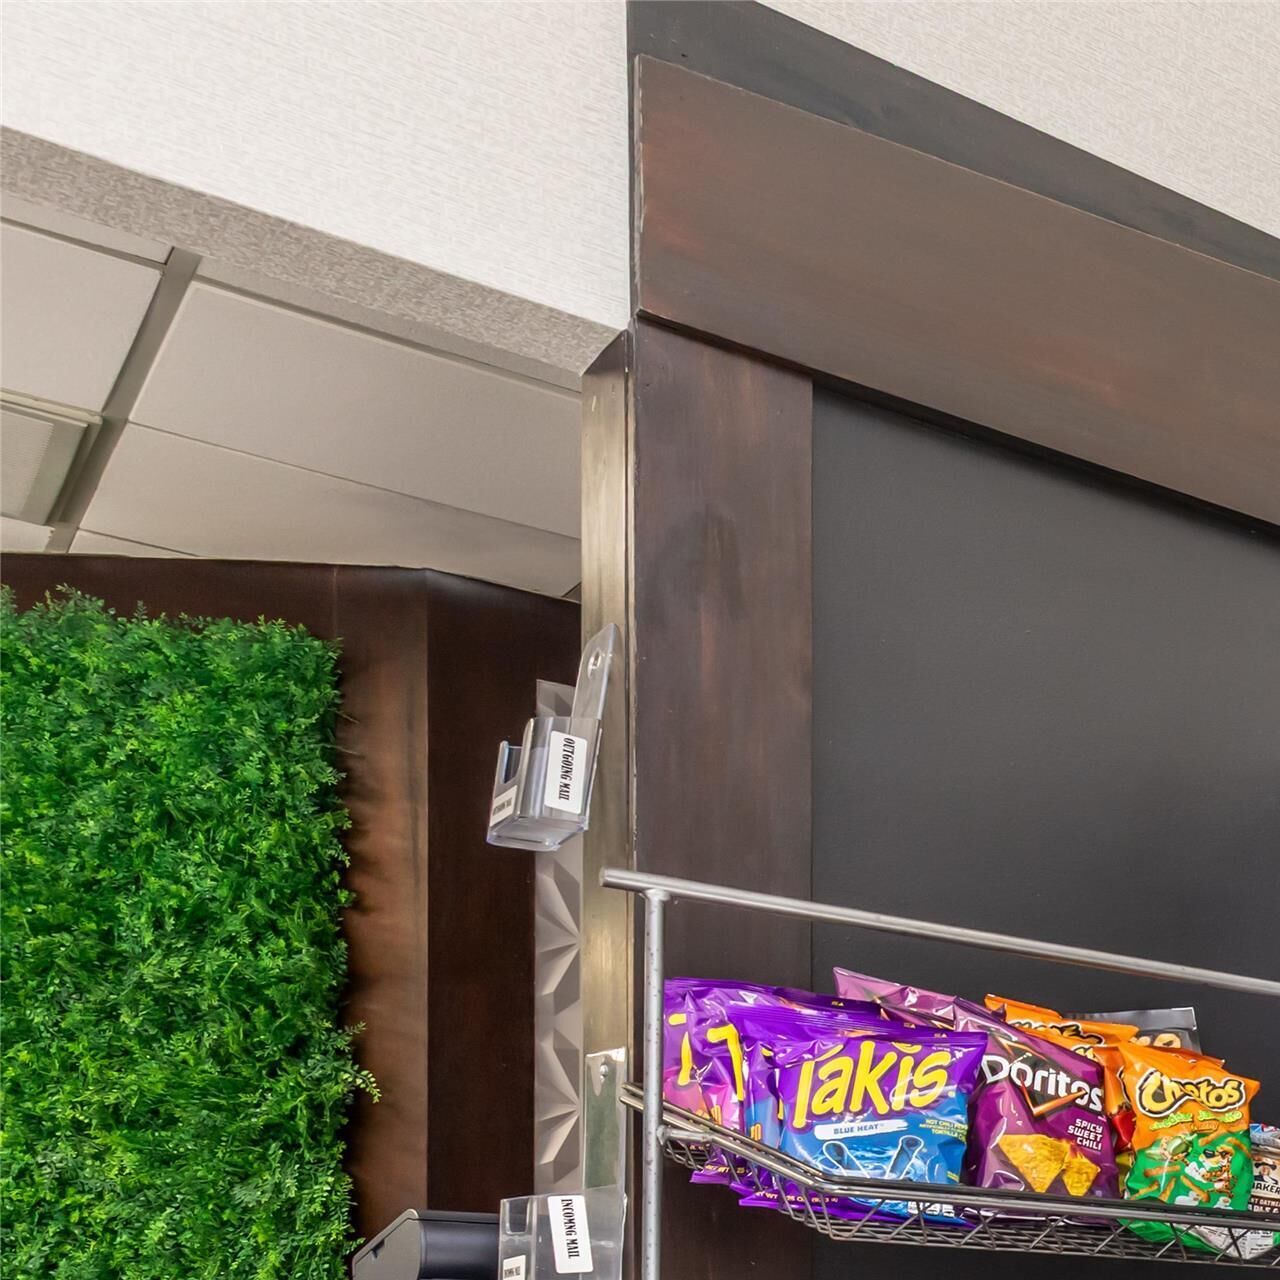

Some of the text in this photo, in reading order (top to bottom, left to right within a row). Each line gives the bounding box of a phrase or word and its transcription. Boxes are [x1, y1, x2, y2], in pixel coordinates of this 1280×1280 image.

[558, 737, 576, 801] OUTGOING MAIL
[788, 1040, 952, 1129] Takis
[982, 1048, 1103, 1112] Doritos
[833, 1123, 880, 1135] BLUE HEAT
[1067, 1125, 1103, 1142] SWEET
[1075, 1118, 1103, 1134] SPICY
[1076, 1136, 1103, 1150] CHILI
[566, 1238, 580, 1259] MAIL
